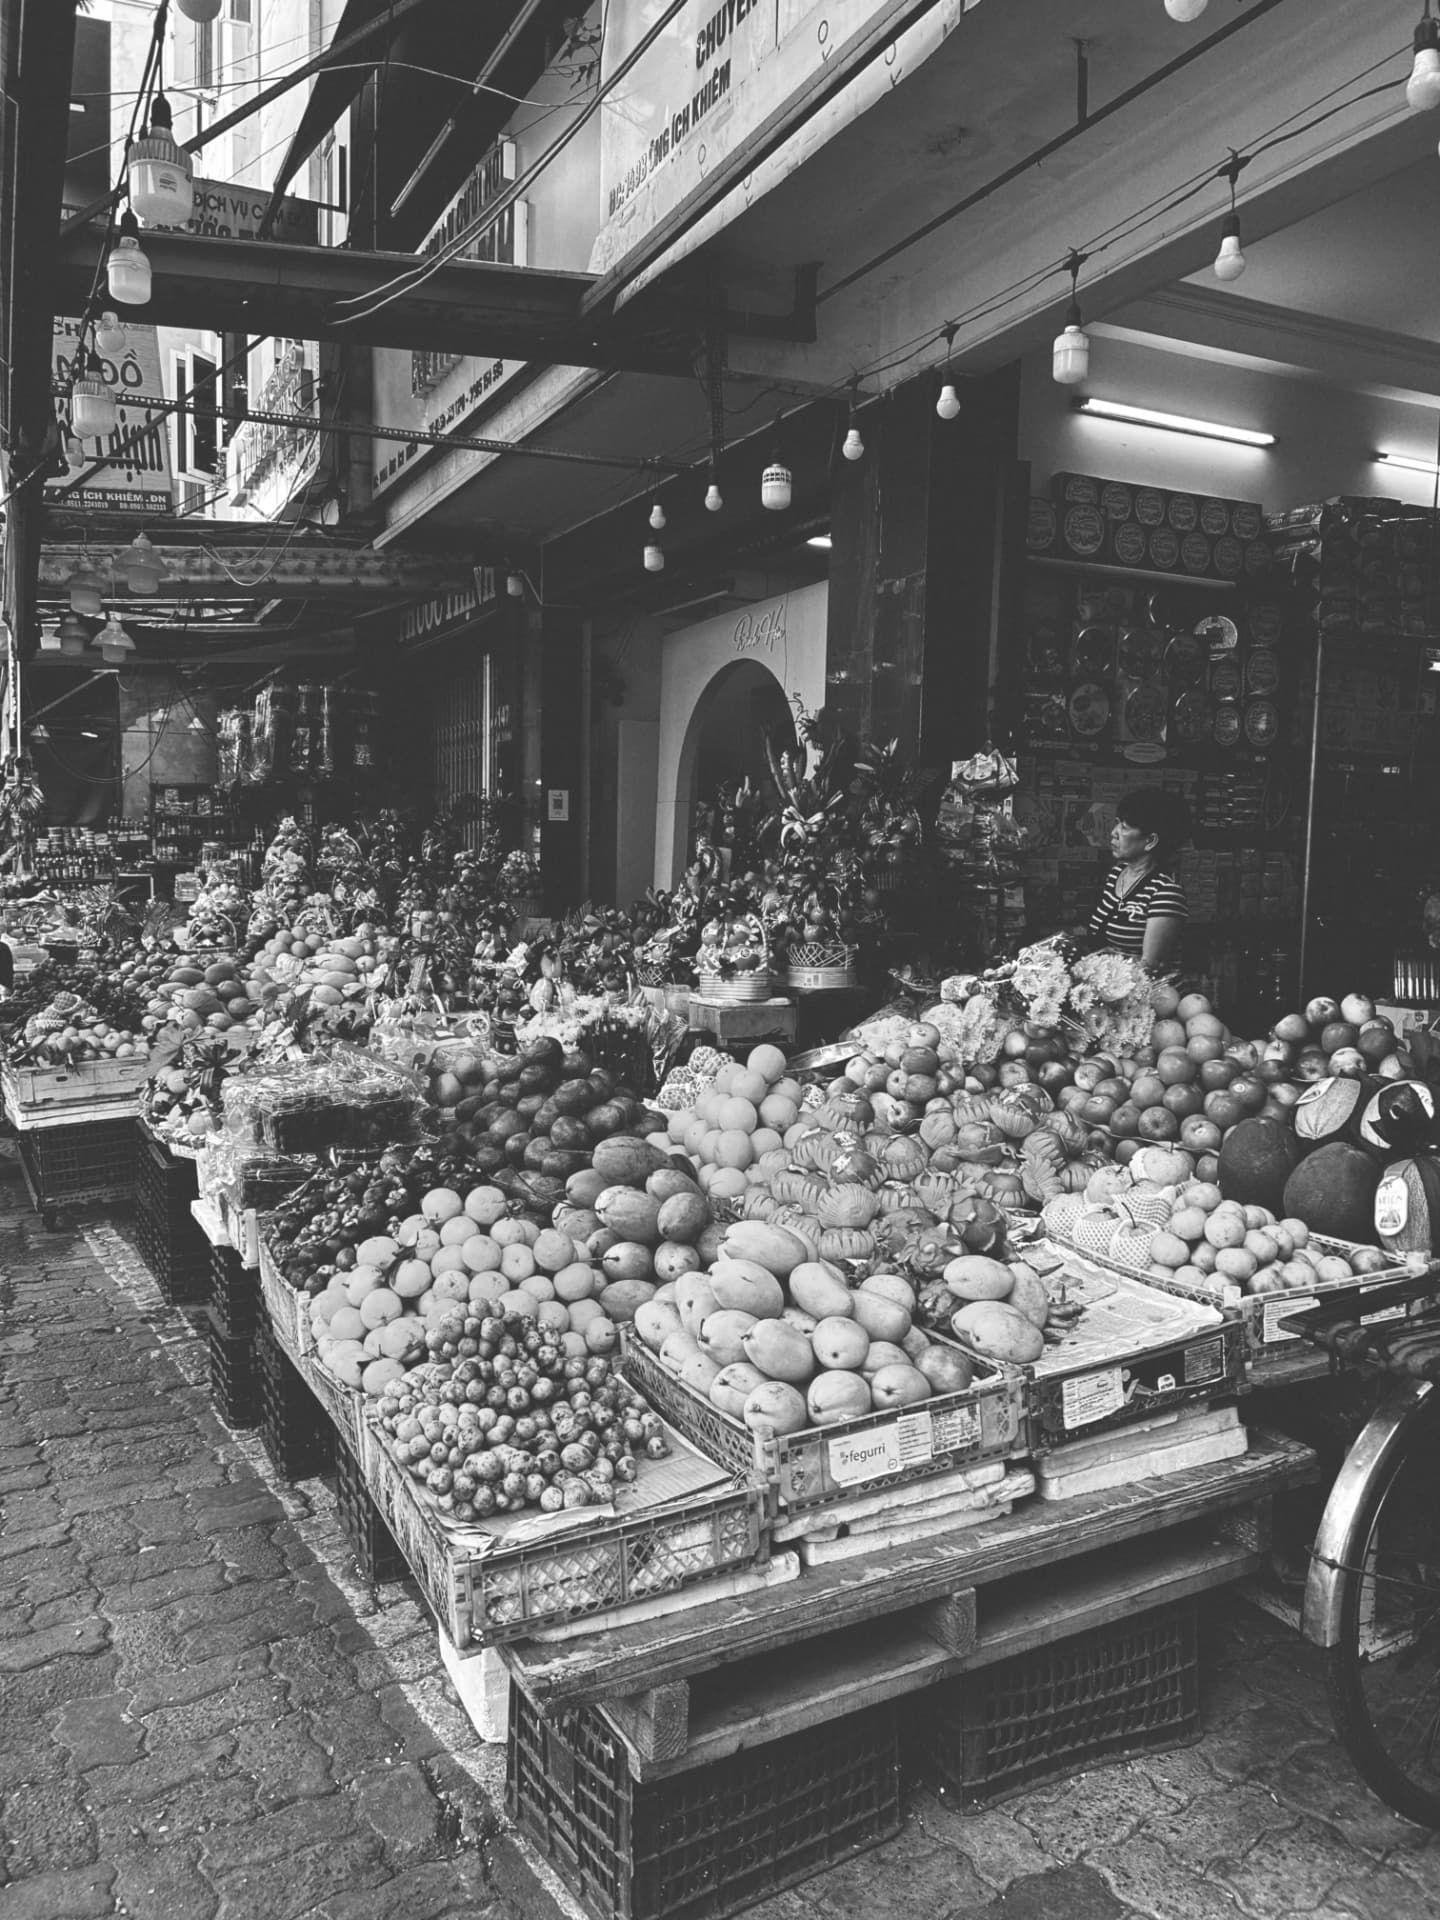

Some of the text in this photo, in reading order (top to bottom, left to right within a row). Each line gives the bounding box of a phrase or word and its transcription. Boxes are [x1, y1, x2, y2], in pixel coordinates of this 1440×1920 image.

[671, 102, 690, 149] ÍCH
[691, 58, 731, 127] KHIÊM
[194, 191, 227, 213] DỊCH
[230, 198, 248, 219] VỤ
[83, 489, 102, 501] ÍCH
[849, 1443, 886, 1463] fegurri
